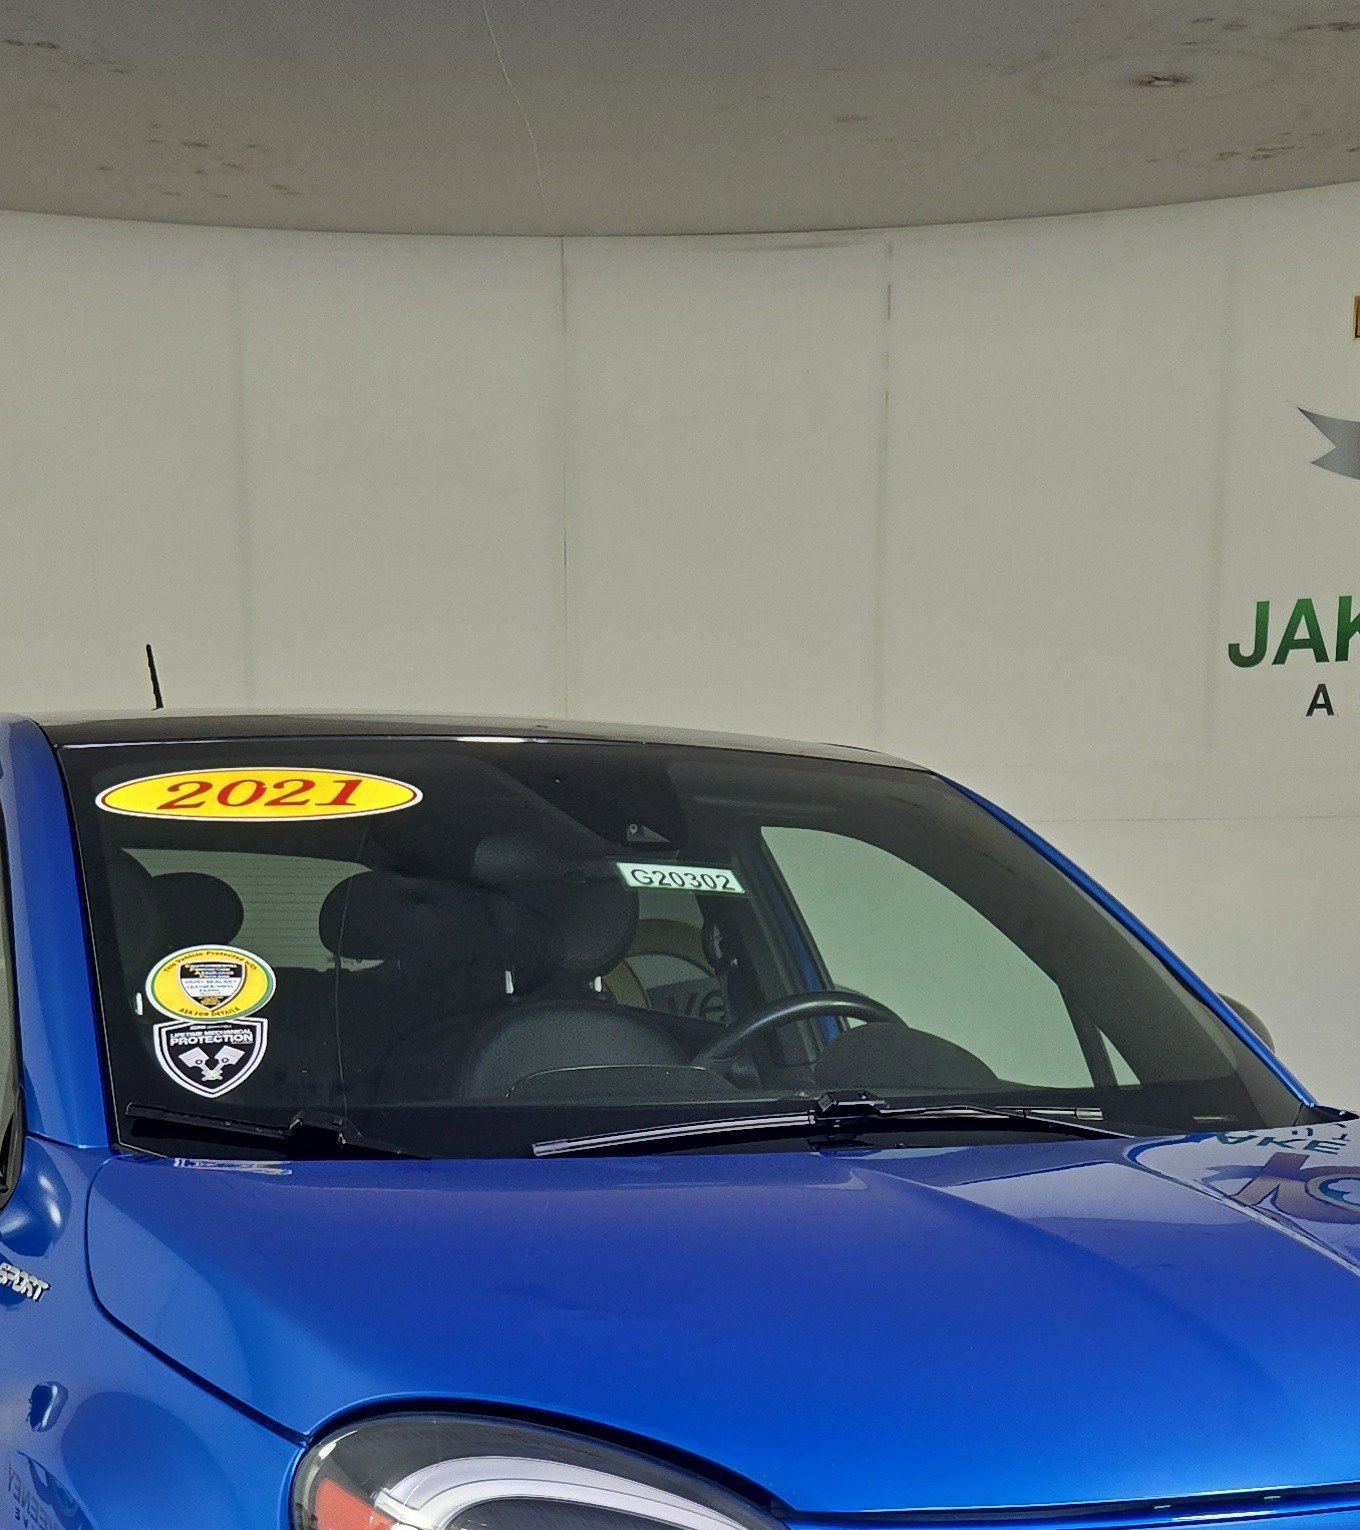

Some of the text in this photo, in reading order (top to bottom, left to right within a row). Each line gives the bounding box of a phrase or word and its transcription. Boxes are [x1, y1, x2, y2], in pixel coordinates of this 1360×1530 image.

[156, 778, 363, 811] 2021
[630, 868, 736, 891] G20302
[170, 1033, 253, 1046] PROTECTION
